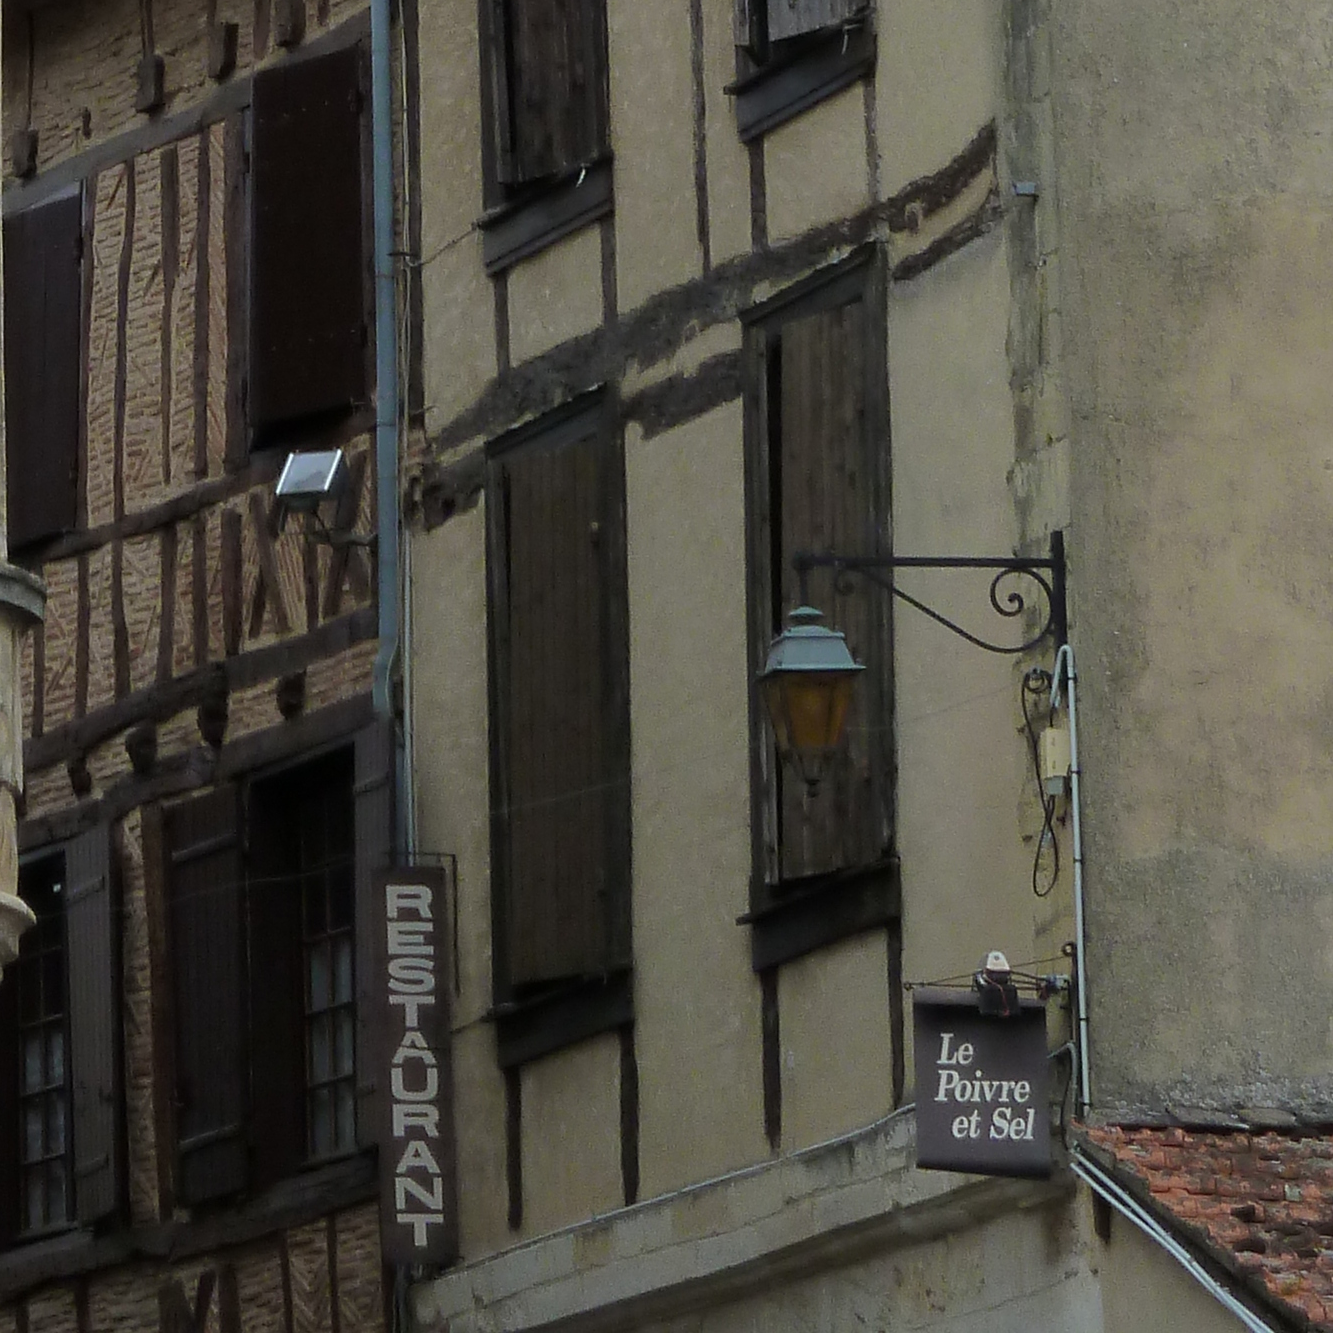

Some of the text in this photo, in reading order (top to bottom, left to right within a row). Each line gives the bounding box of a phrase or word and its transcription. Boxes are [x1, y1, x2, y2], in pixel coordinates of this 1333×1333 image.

[385, 884, 445, 1247] RESTAURANT
[936, 1033, 974, 1065] Le
[934, 1069, 1031, 1103] Poivre
[952, 1106, 1036, 1141] et Sel
